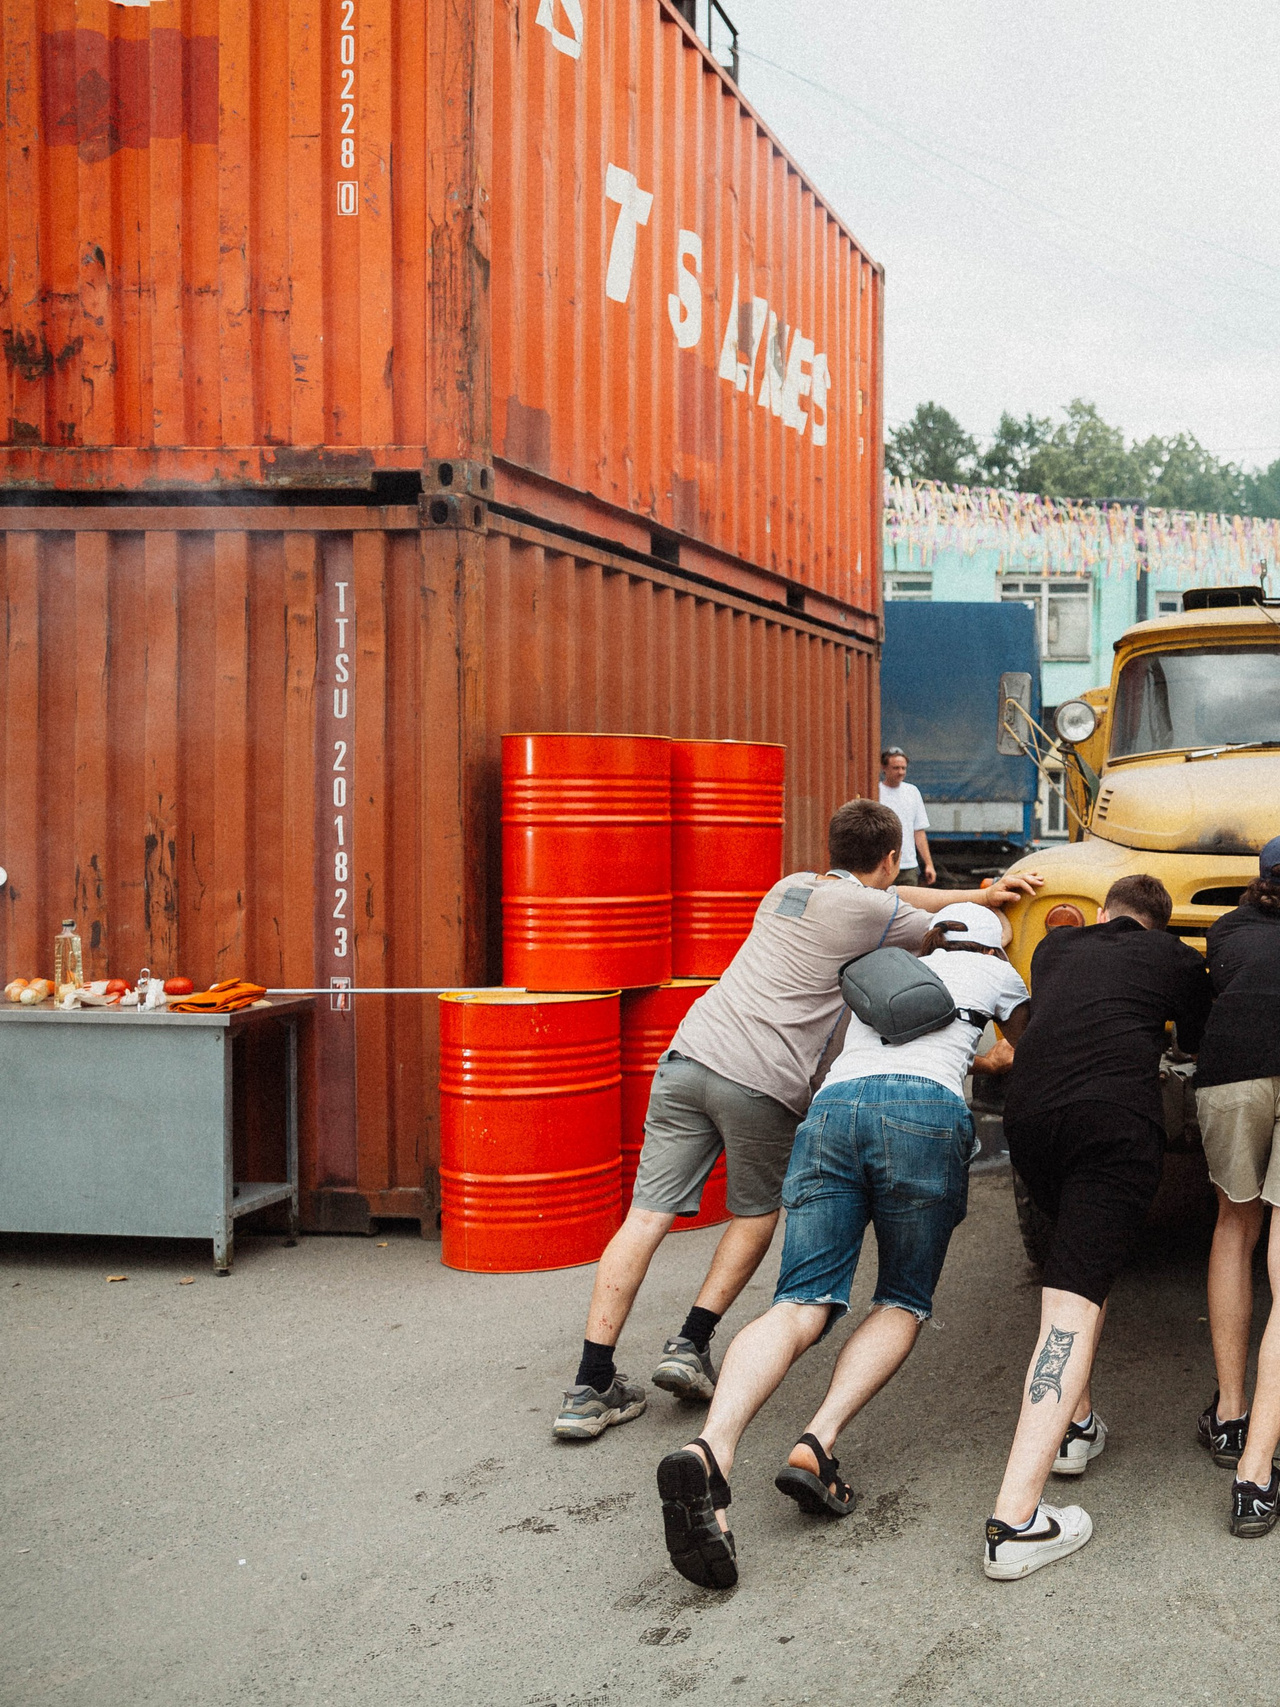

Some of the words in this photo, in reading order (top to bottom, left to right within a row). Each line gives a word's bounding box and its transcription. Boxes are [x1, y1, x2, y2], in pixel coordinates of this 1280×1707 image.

[605, 162, 654, 303] T
[667, 229, 702, 348] S
[718, 272, 832, 446] LINES
[333, 581, 350, 719] TTSU
[332, 740, 349, 957] 201823
